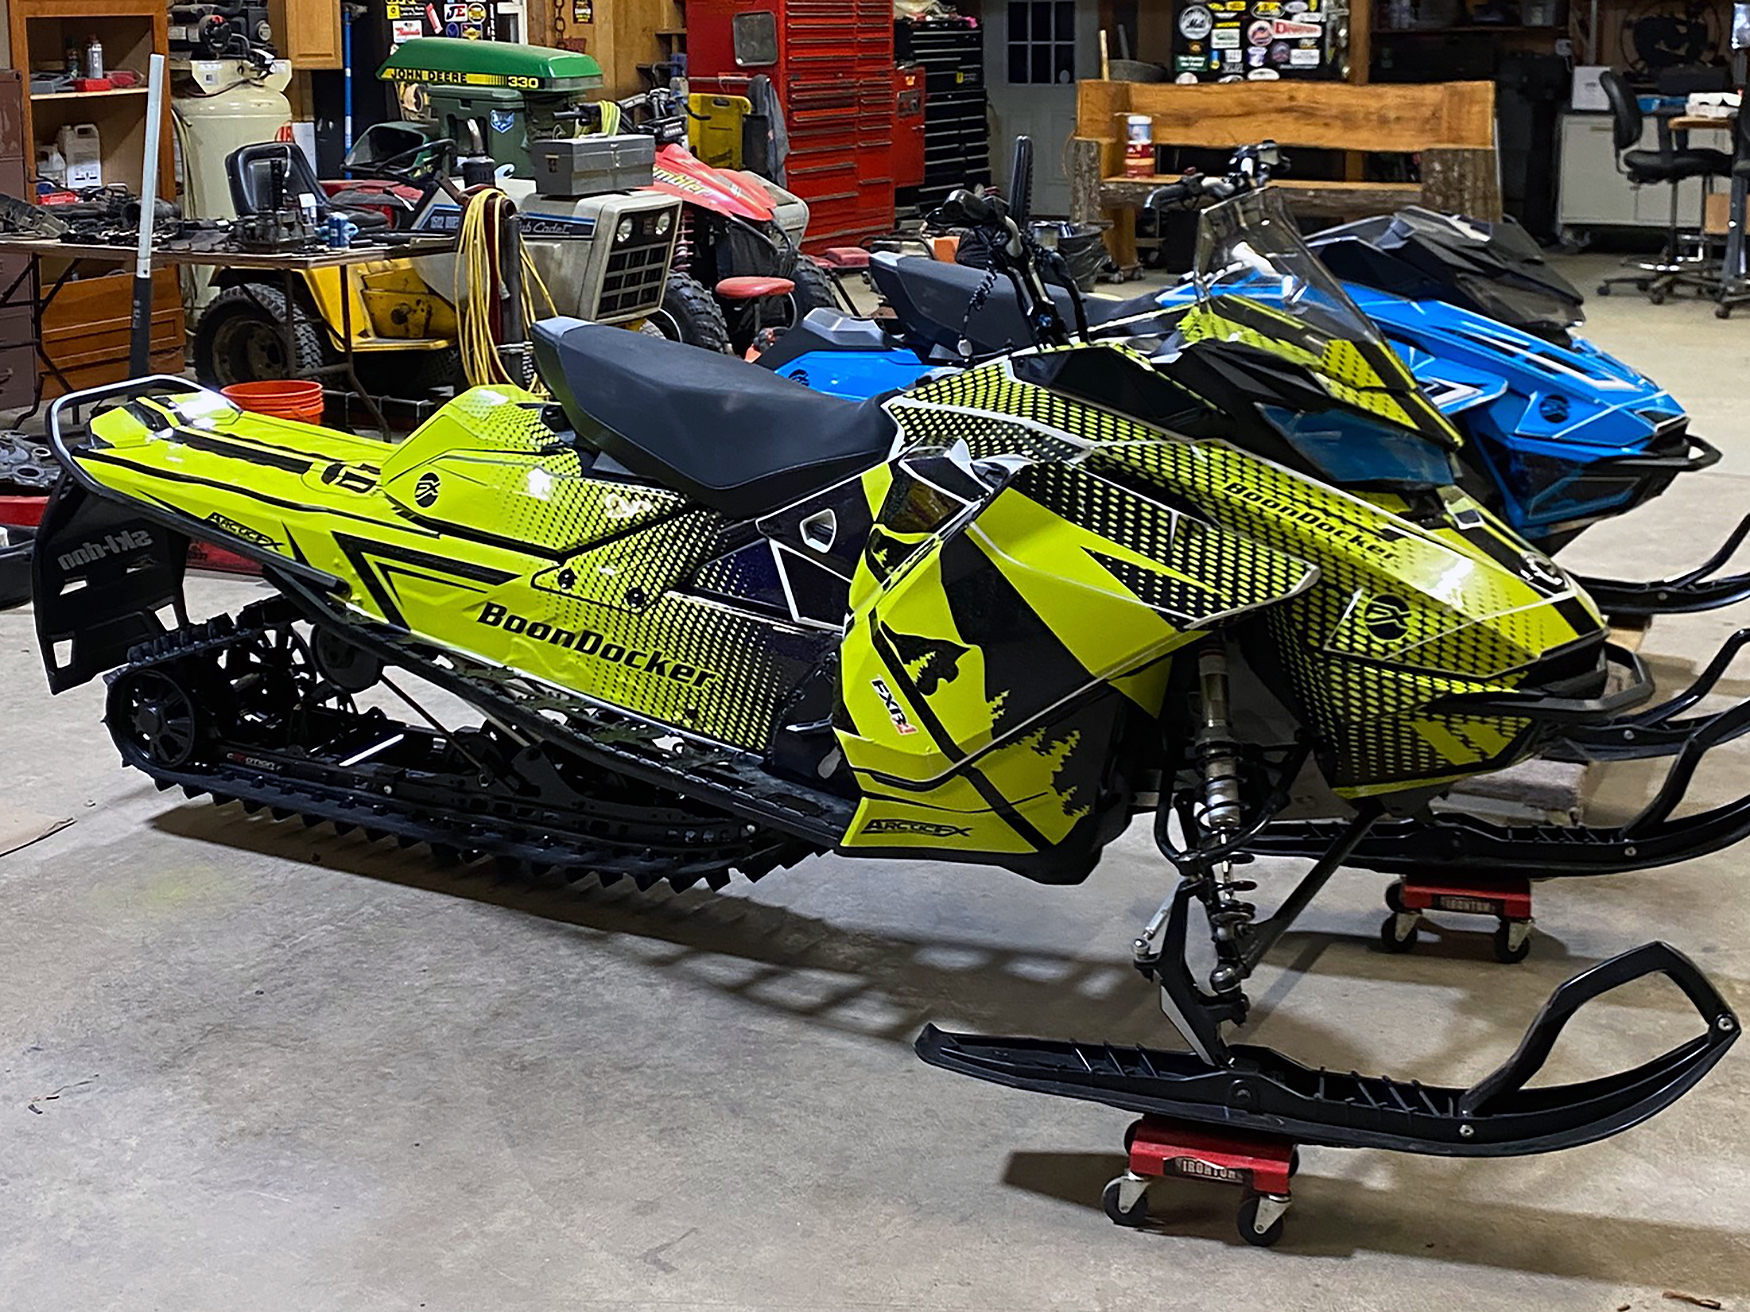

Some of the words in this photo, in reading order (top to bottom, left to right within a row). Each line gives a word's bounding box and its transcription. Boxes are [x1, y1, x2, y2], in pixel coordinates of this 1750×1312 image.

[445, 5, 466, 20] JE
[390, 68, 423, 81] JOHN
[428, 70, 468, 83] DEERE
[508, 76, 539, 89] 330
[1224, 482, 1399, 560] BoonDocker
[477, 602, 718, 688] BoonDocker
